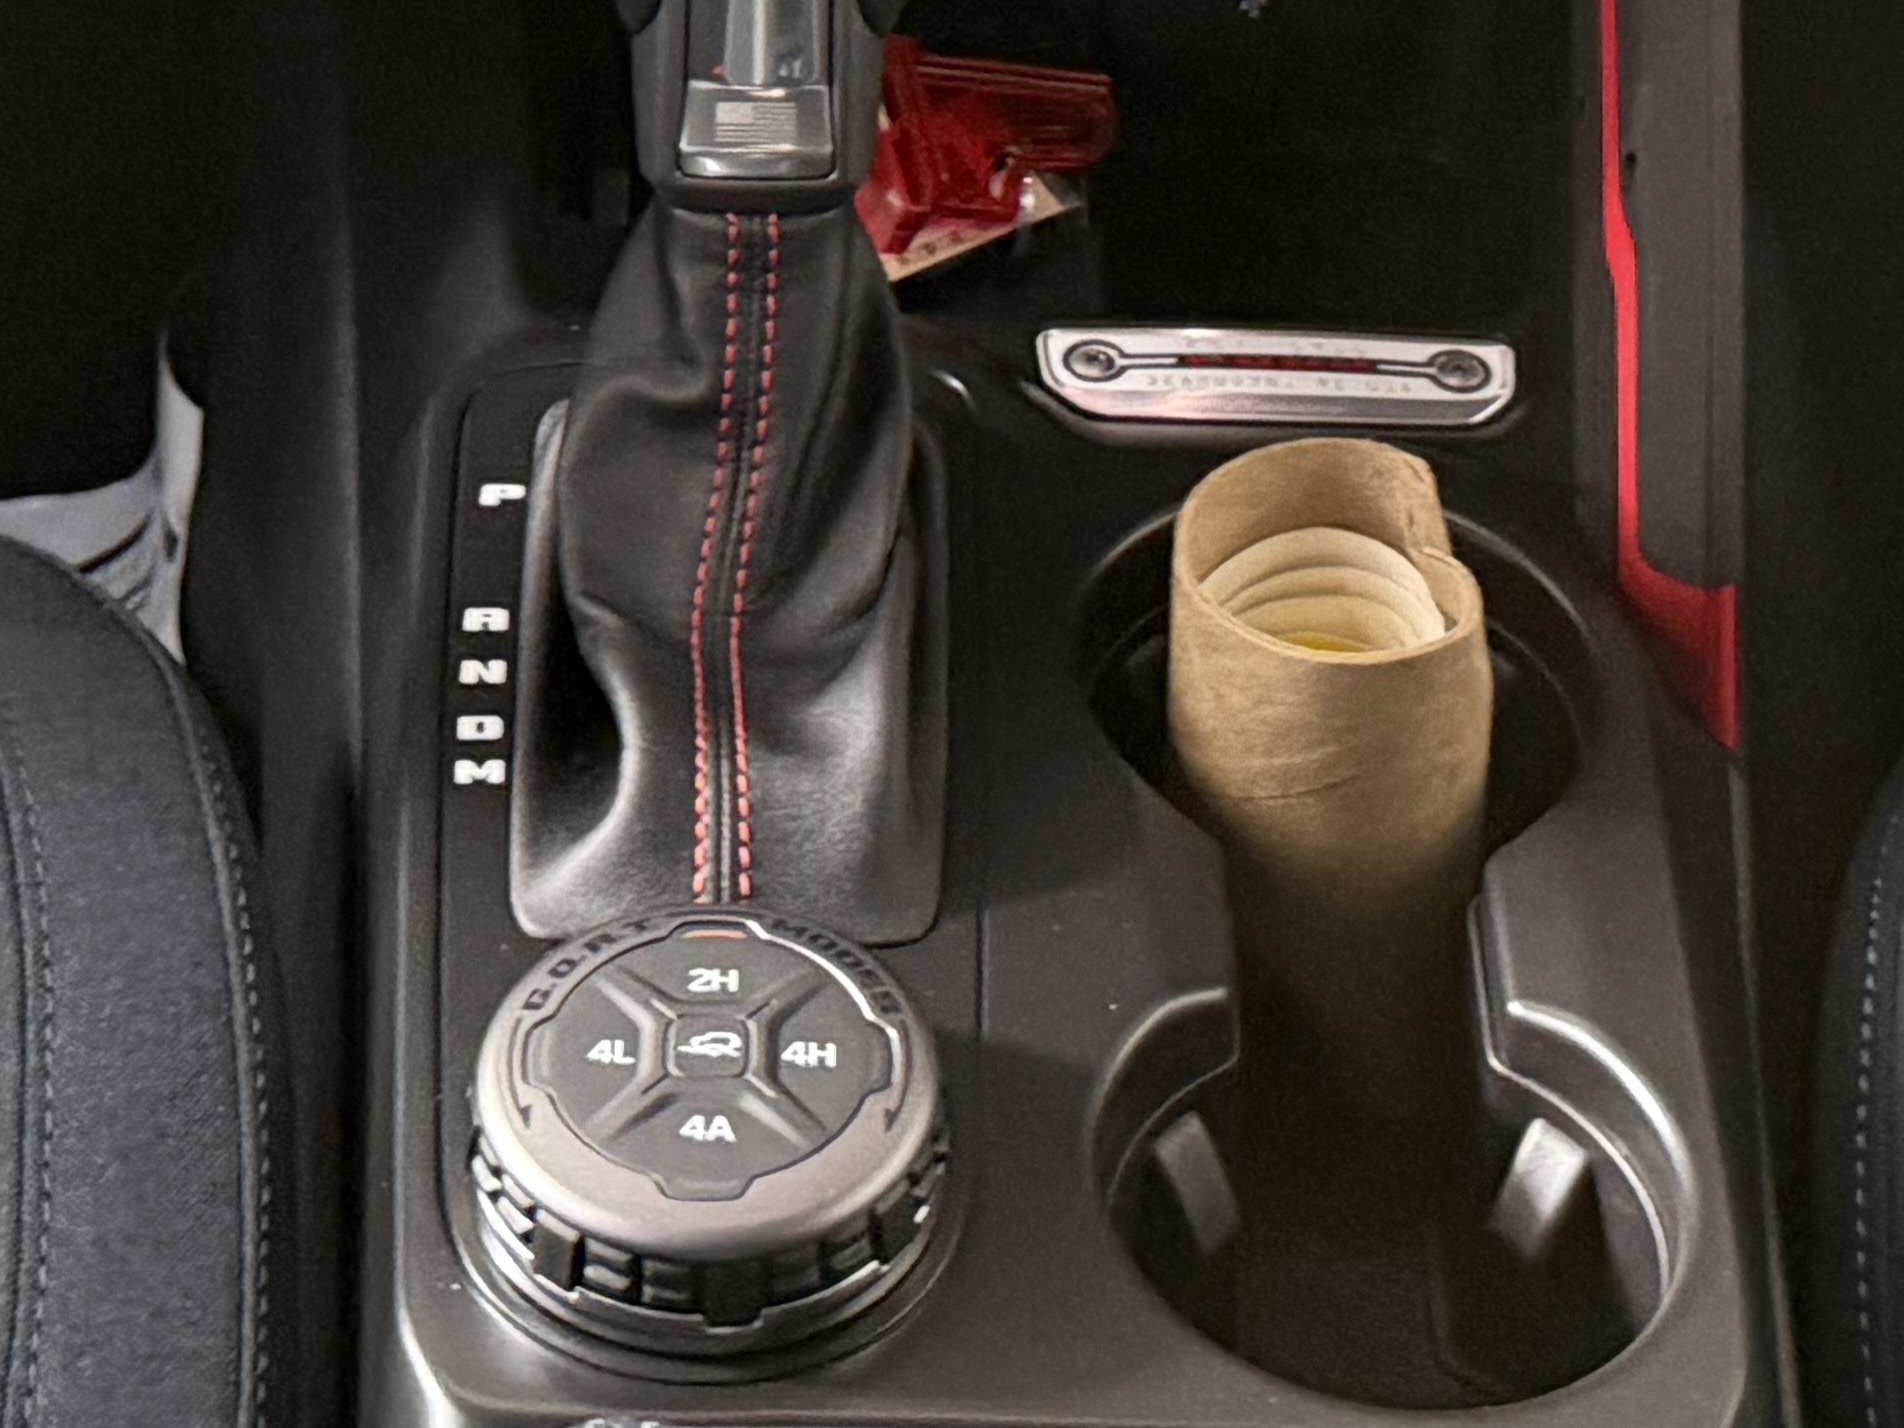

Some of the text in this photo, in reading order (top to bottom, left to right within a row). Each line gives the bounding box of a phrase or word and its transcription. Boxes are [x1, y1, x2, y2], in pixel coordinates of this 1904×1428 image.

[478, 483, 527, 506] P
[458, 659, 508, 684] N
[456, 715, 505, 741] D
[453, 758, 507, 785] M
[686, 968, 739, 993] 2H
[585, 1039, 636, 1064] 4L
[780, 1041, 837, 1068] 4H
[678, 1114, 737, 1143] 4A
